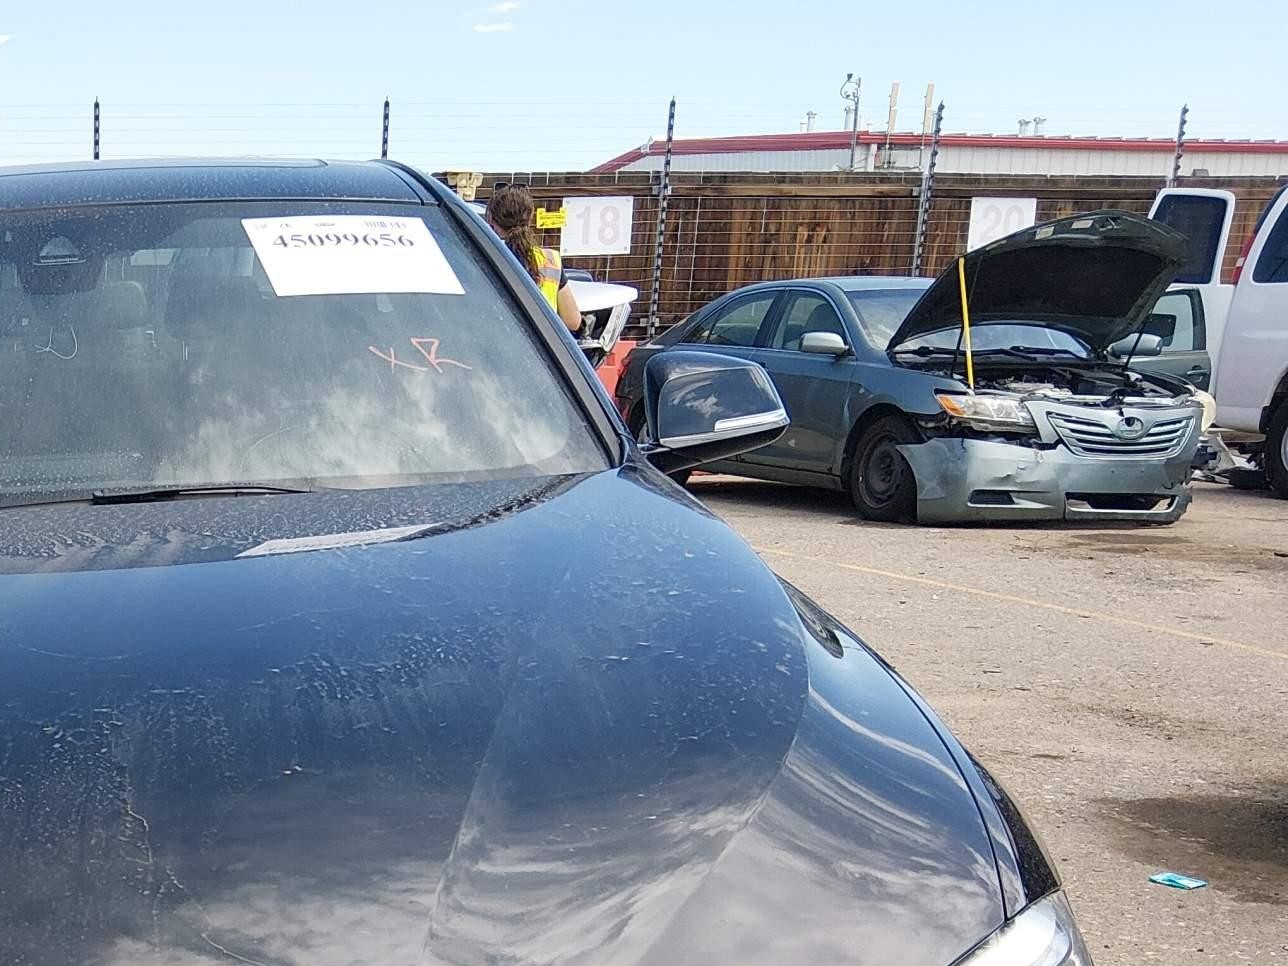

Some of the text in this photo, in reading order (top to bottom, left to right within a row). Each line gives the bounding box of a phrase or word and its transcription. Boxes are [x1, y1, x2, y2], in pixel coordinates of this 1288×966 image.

[271, 232, 415, 249] 45099656
[575, 205, 620, 246] 18
[978, 205, 1025, 243] 20
